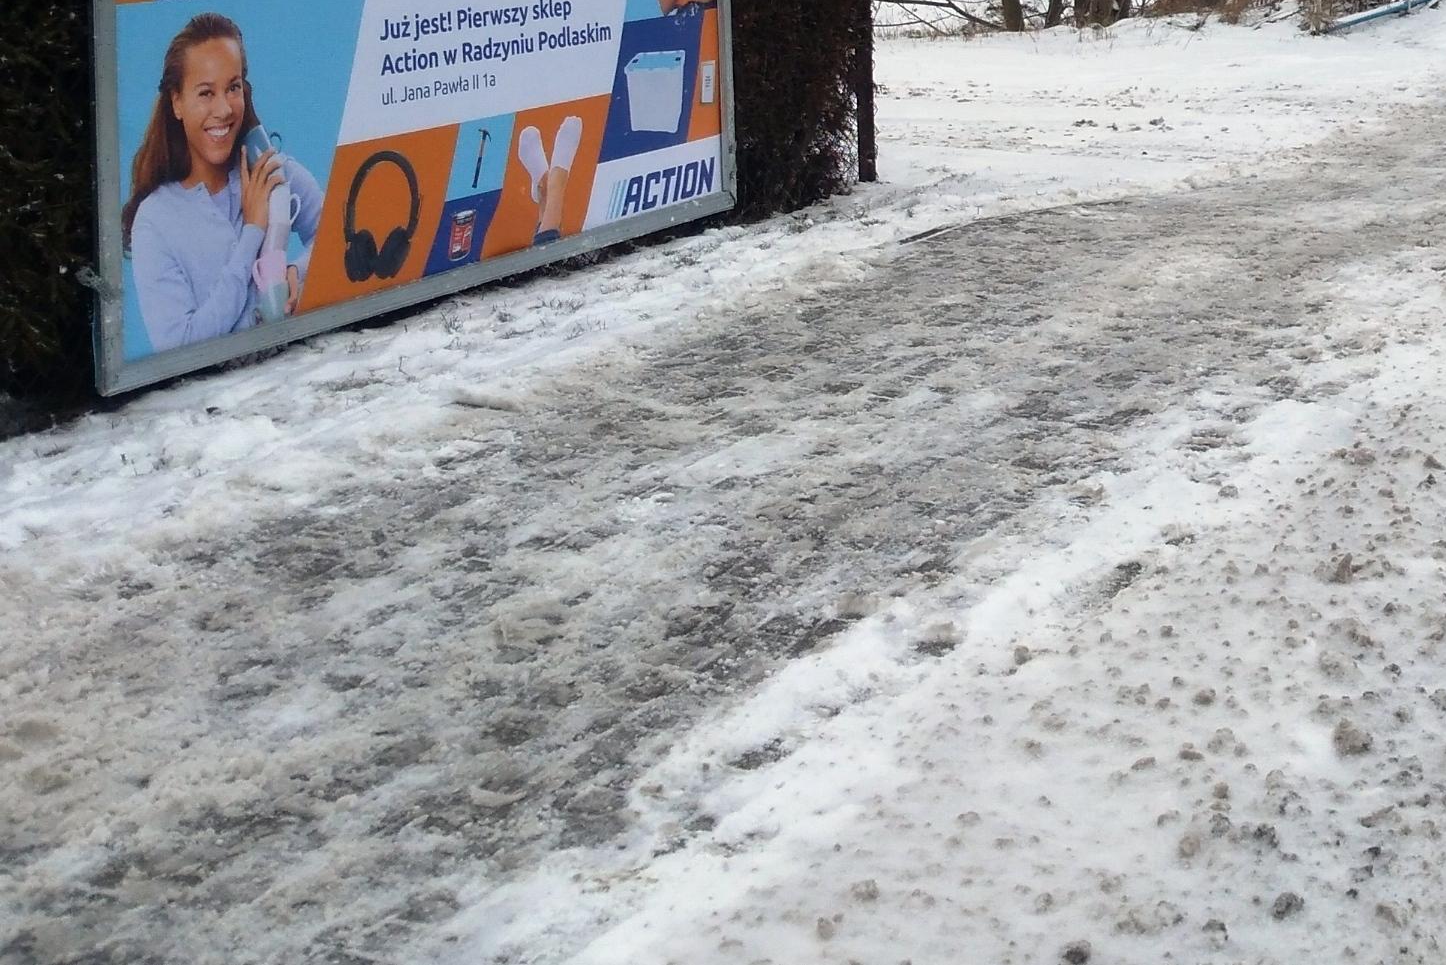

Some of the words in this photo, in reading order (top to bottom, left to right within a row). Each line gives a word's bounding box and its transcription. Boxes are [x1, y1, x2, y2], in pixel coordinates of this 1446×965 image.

[379, 15, 411, 41] Już
[414, 11, 453, 41] jest!
[457, 4, 529, 30] Pierwszy
[380, 48, 439, 76] Action
[443, 47, 458, 65] w
[462, 33, 534, 64] Radzyniu
[538, 22, 612, 51] Podlaskim
[381, 89, 398, 106] ul.
[400, 85, 431, 103] Jana
[434, 75, 469, 97] Pawła
[472, 74, 479, 91] II
[482, 72, 496, 88] 1a
[621, 156, 715, 217] ACTION
